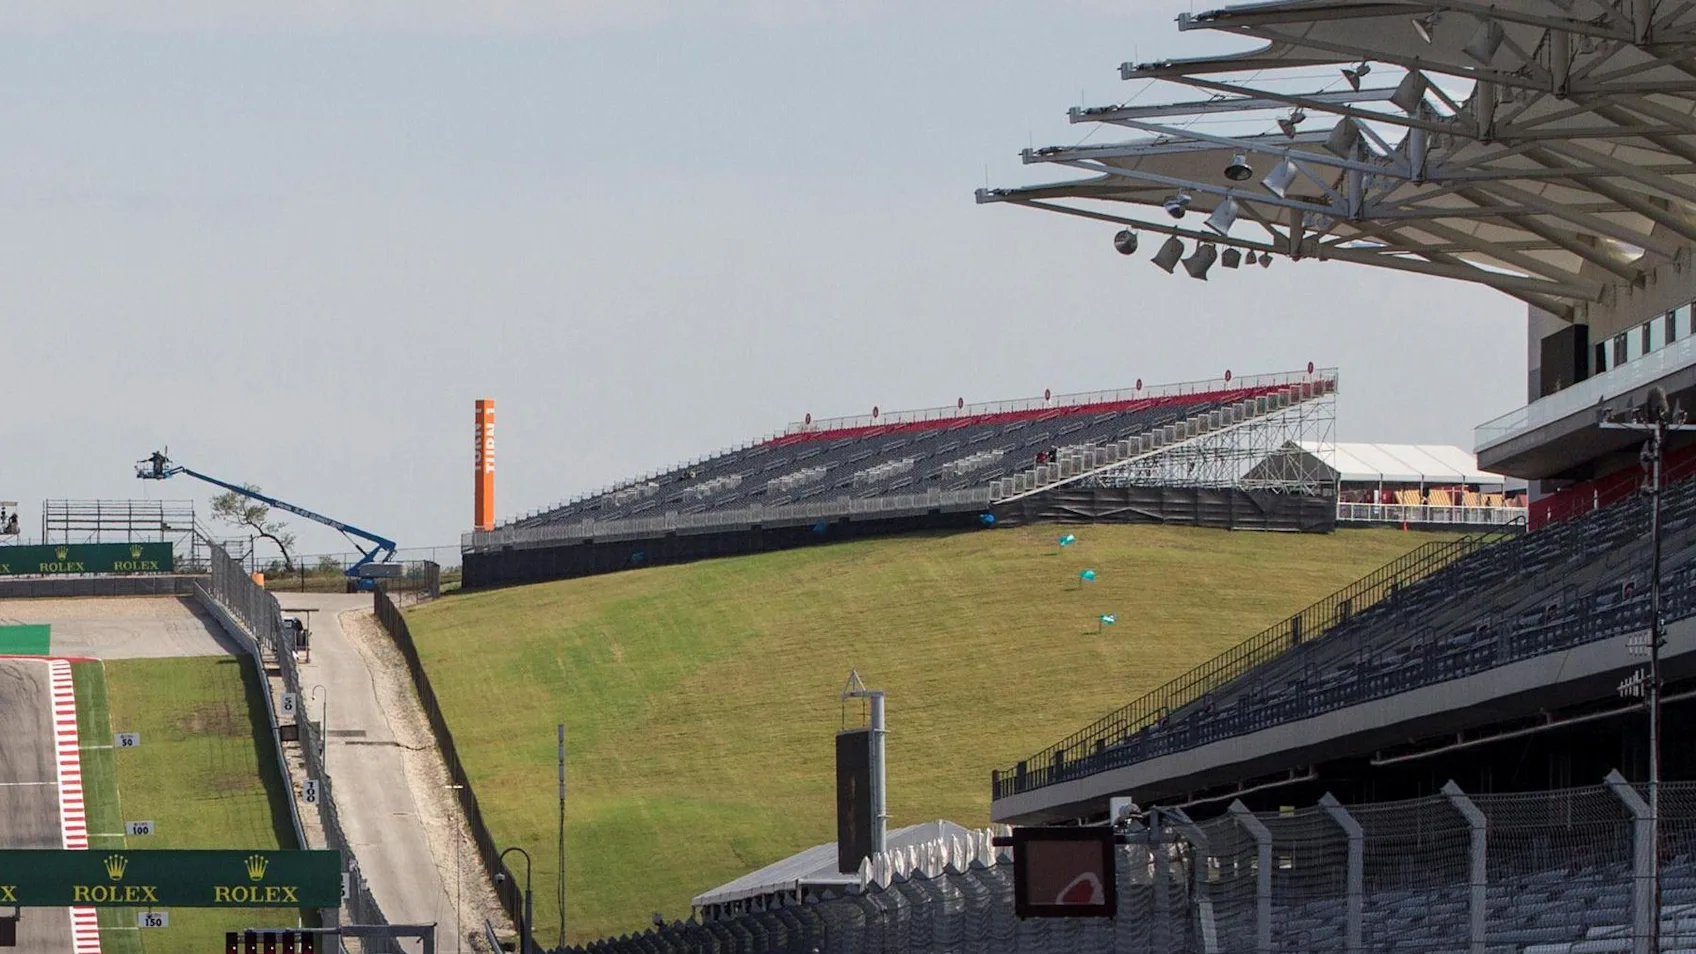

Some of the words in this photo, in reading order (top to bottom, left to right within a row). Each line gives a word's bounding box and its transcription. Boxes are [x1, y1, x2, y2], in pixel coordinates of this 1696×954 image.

[40, 562, 85, 573] ROLEX
[114, 561, 159, 572] ROLEX
[122, 738, 133, 746] 50
[133, 826, 149, 835] 100
[74, 886, 158, 902] ROLEX
[214, 886, 299, 903] ROLEX
[145, 918, 162, 927] 150
